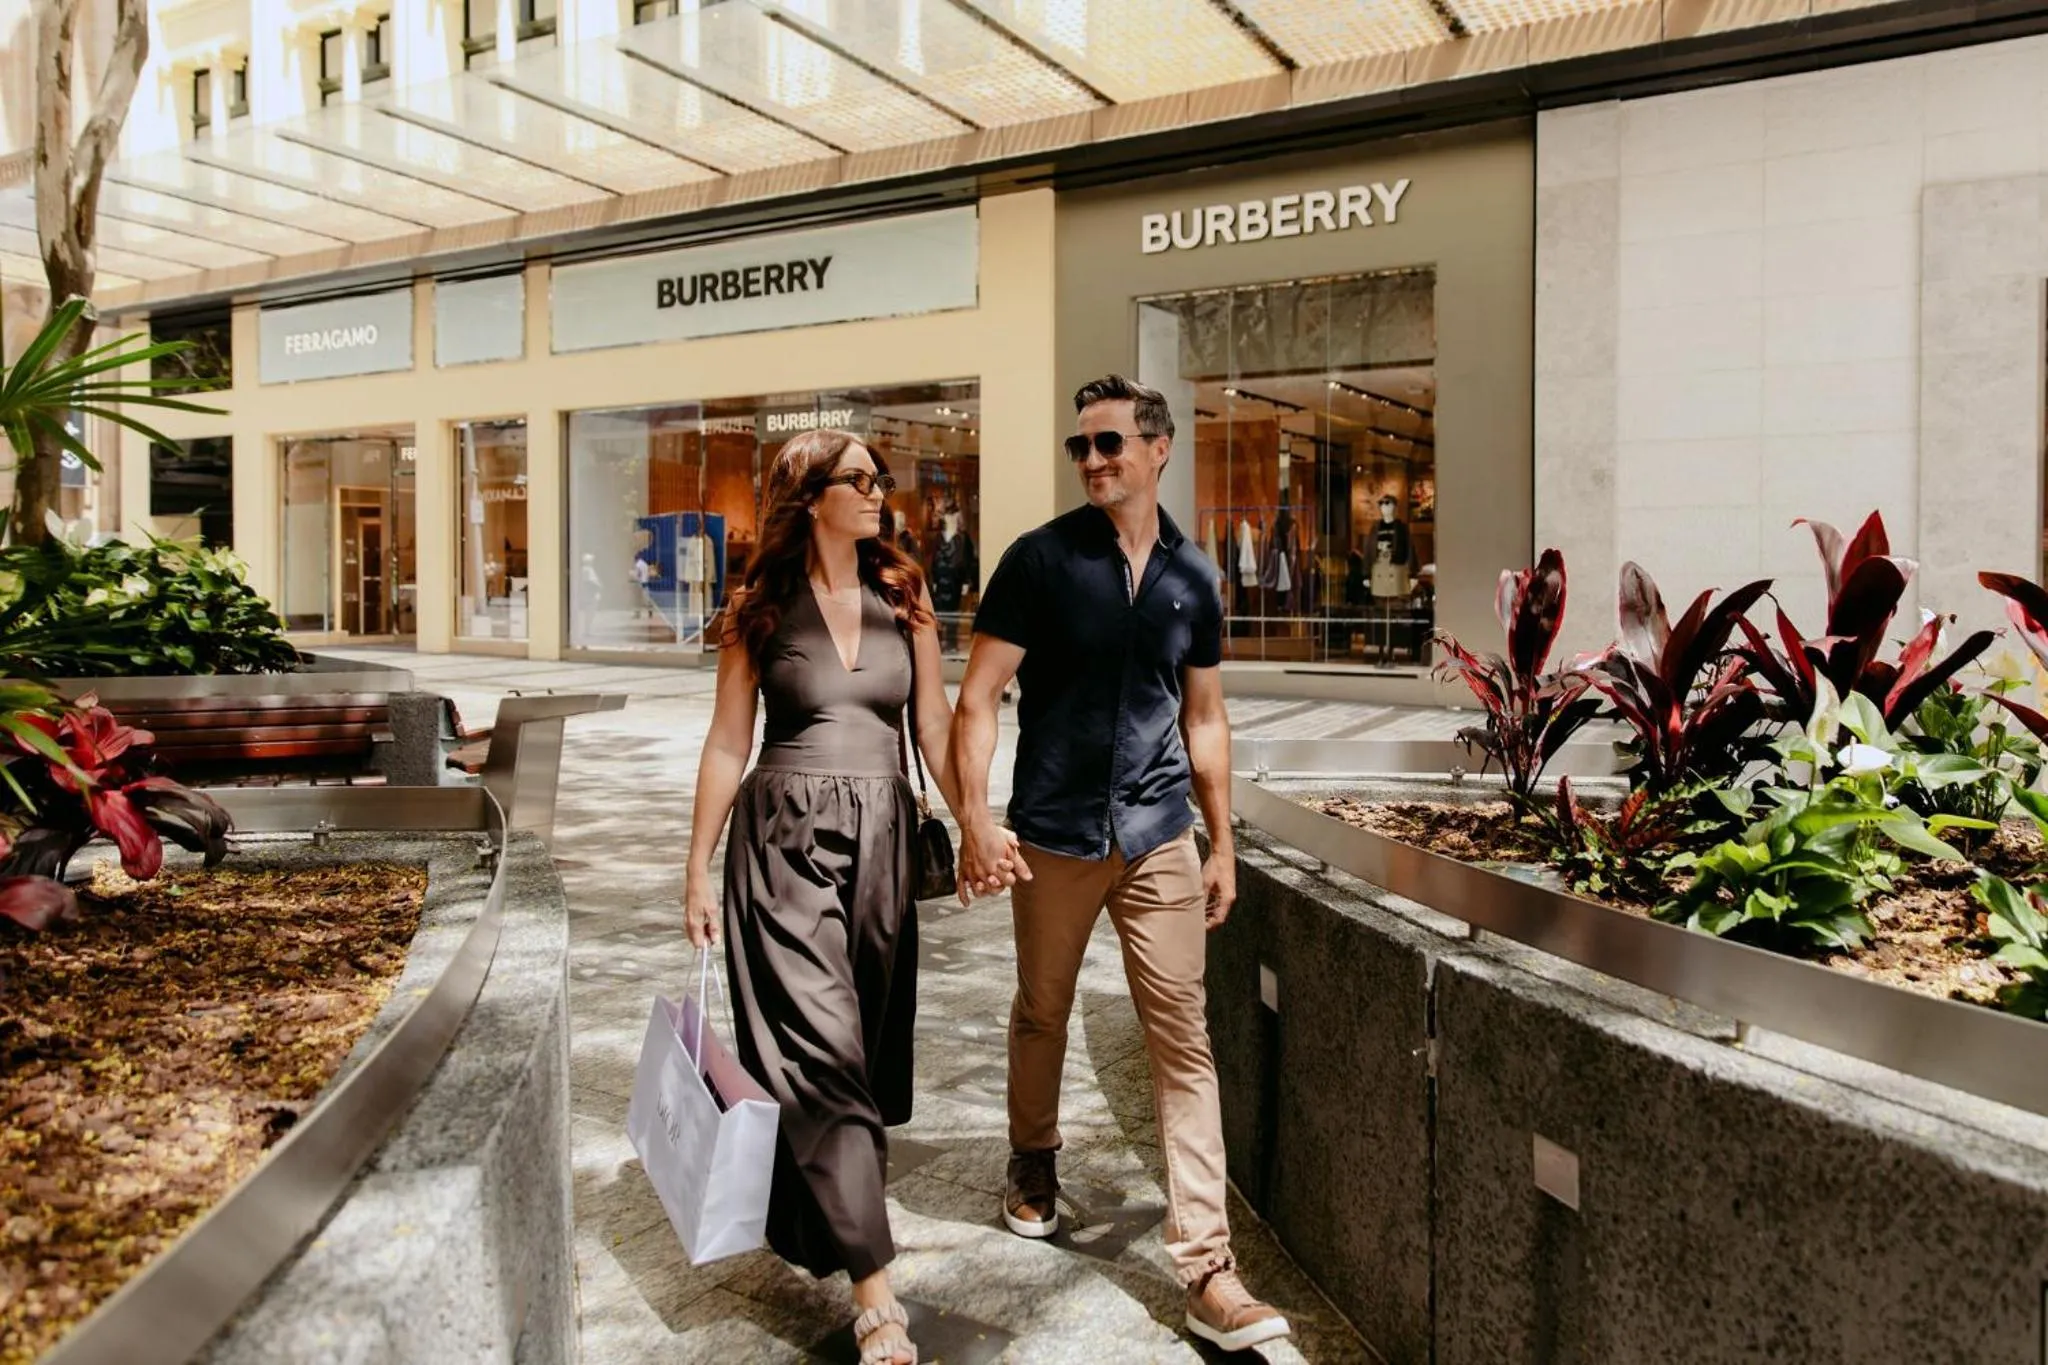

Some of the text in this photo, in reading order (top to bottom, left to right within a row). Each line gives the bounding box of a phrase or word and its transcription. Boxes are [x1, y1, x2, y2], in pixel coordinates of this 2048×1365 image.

[1142, 178, 1411, 254] BURBERRY
[657, 255, 833, 309] BURBERRY
[285, 324, 378, 355] FERRAGAMO
[766, 409, 854, 432] BURBERRY
